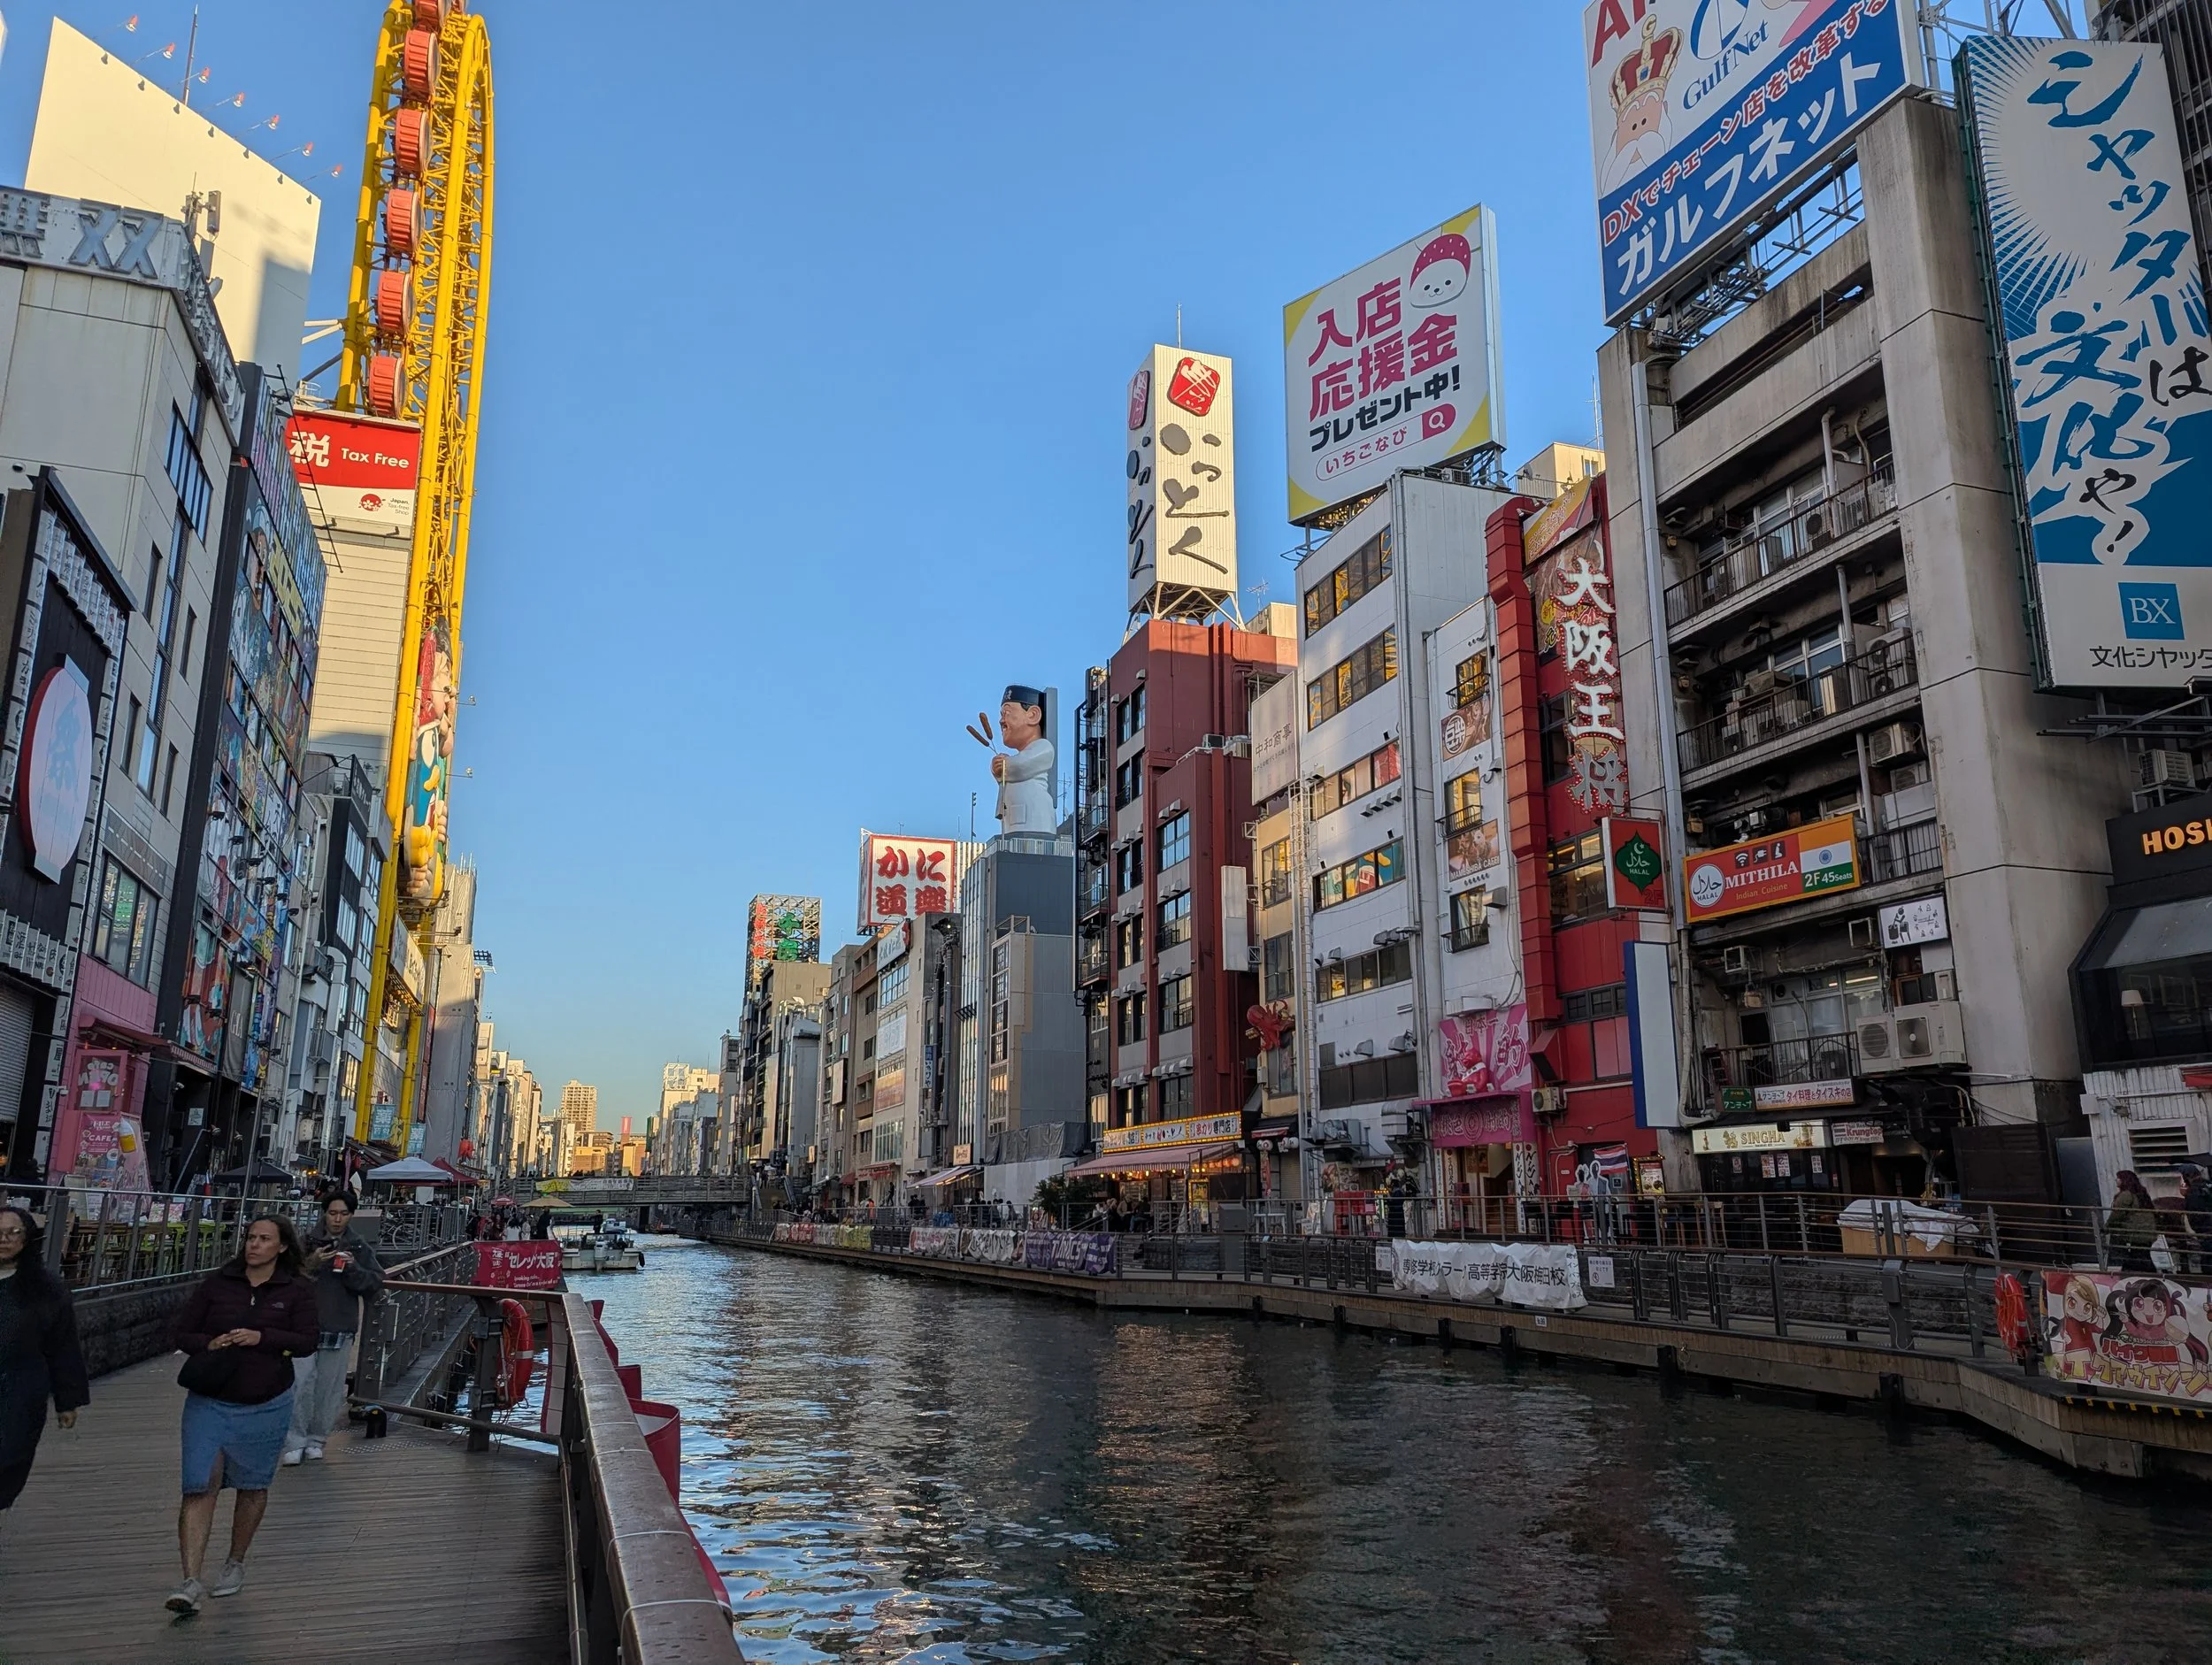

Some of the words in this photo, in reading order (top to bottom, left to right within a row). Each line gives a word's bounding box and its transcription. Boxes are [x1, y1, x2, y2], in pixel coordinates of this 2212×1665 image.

[1683, 19, 1769, 111] GulfNet
[1617, 50, 1881, 296] ガルフネット
[1308, 276, 1402, 368] 入店
[1310, 312, 1457, 423] 応援金
[1310, 364, 1461, 453] プレゼント中!
[341, 447, 370, 463] Tax
[374, 453, 410, 469] Free
[1325, 426, 1409, 474] いちごなび
[1159, 422, 1230, 576] いっとく
[2128, 597, 2177, 625] BX
[1549, 556, 1628, 814] 大阪王将
[1255, 723, 1293, 758] 中和商事
[876, 846, 947, 882] かに
[1450, 863, 1482, 880] MAMESHIBA
[1629, 867, 1650, 876] HALAL
[1724, 861, 1799, 889] MITHILA
[1804, 871, 1821, 887] 2F
[1644, 888, 1664, 905] 2F
[1696, 891, 1719, 902] HALAL
[1736, 889, 1758, 901] Indian
[1761, 882, 1788, 895] Cuisine
[1786, 1086, 1852, 1102] タイ料理とタイスキの店
[1741, 1130, 1786, 1144] SINGHA
[1525, 1151, 1538, 1186] NINJA
